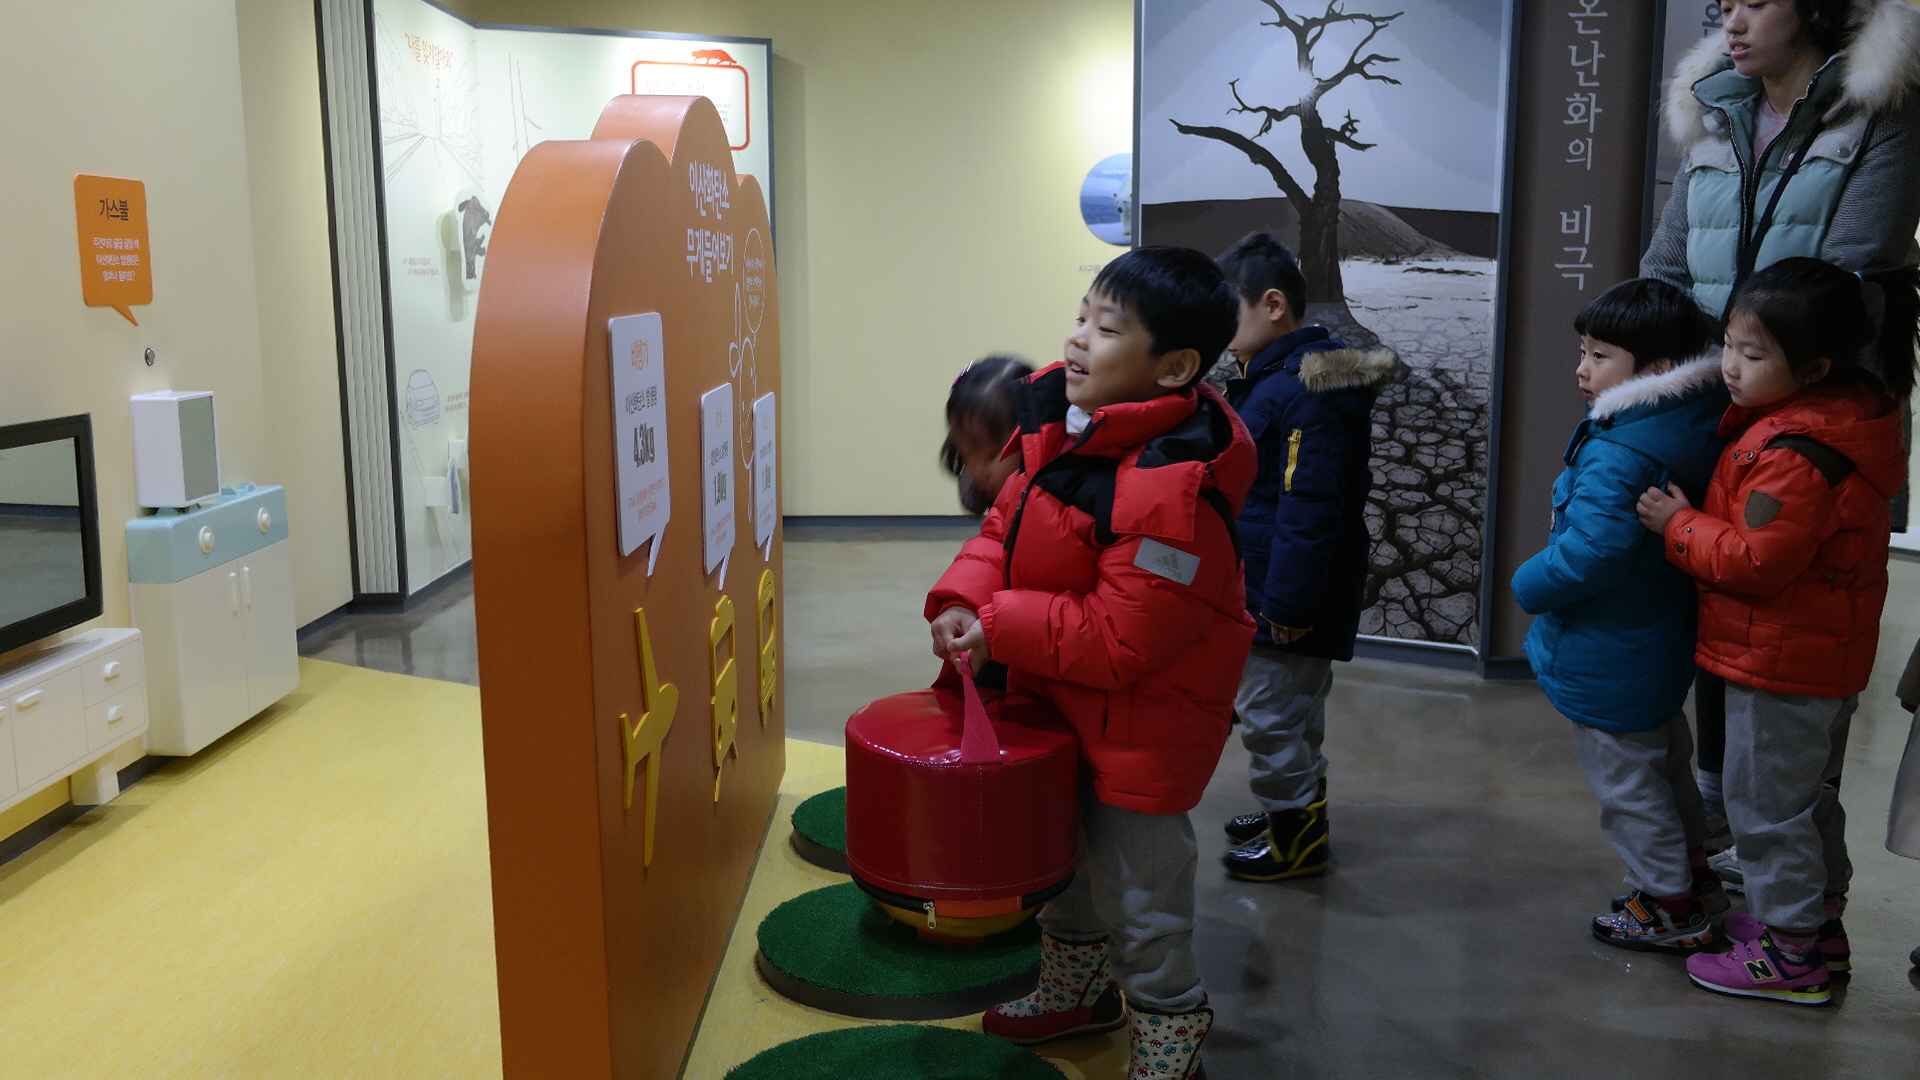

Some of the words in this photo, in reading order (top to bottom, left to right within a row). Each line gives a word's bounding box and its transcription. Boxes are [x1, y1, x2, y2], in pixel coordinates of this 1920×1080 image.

[689, 160, 730, 219] 이산화탄소
[99, 198, 129, 221] 가스불
[1554, 204, 1594, 291] 비극
[630, 337, 649, 371] 비행기
[633, 423, 655, 468] 4.3kg
[1744, 959, 1775, 980] N
